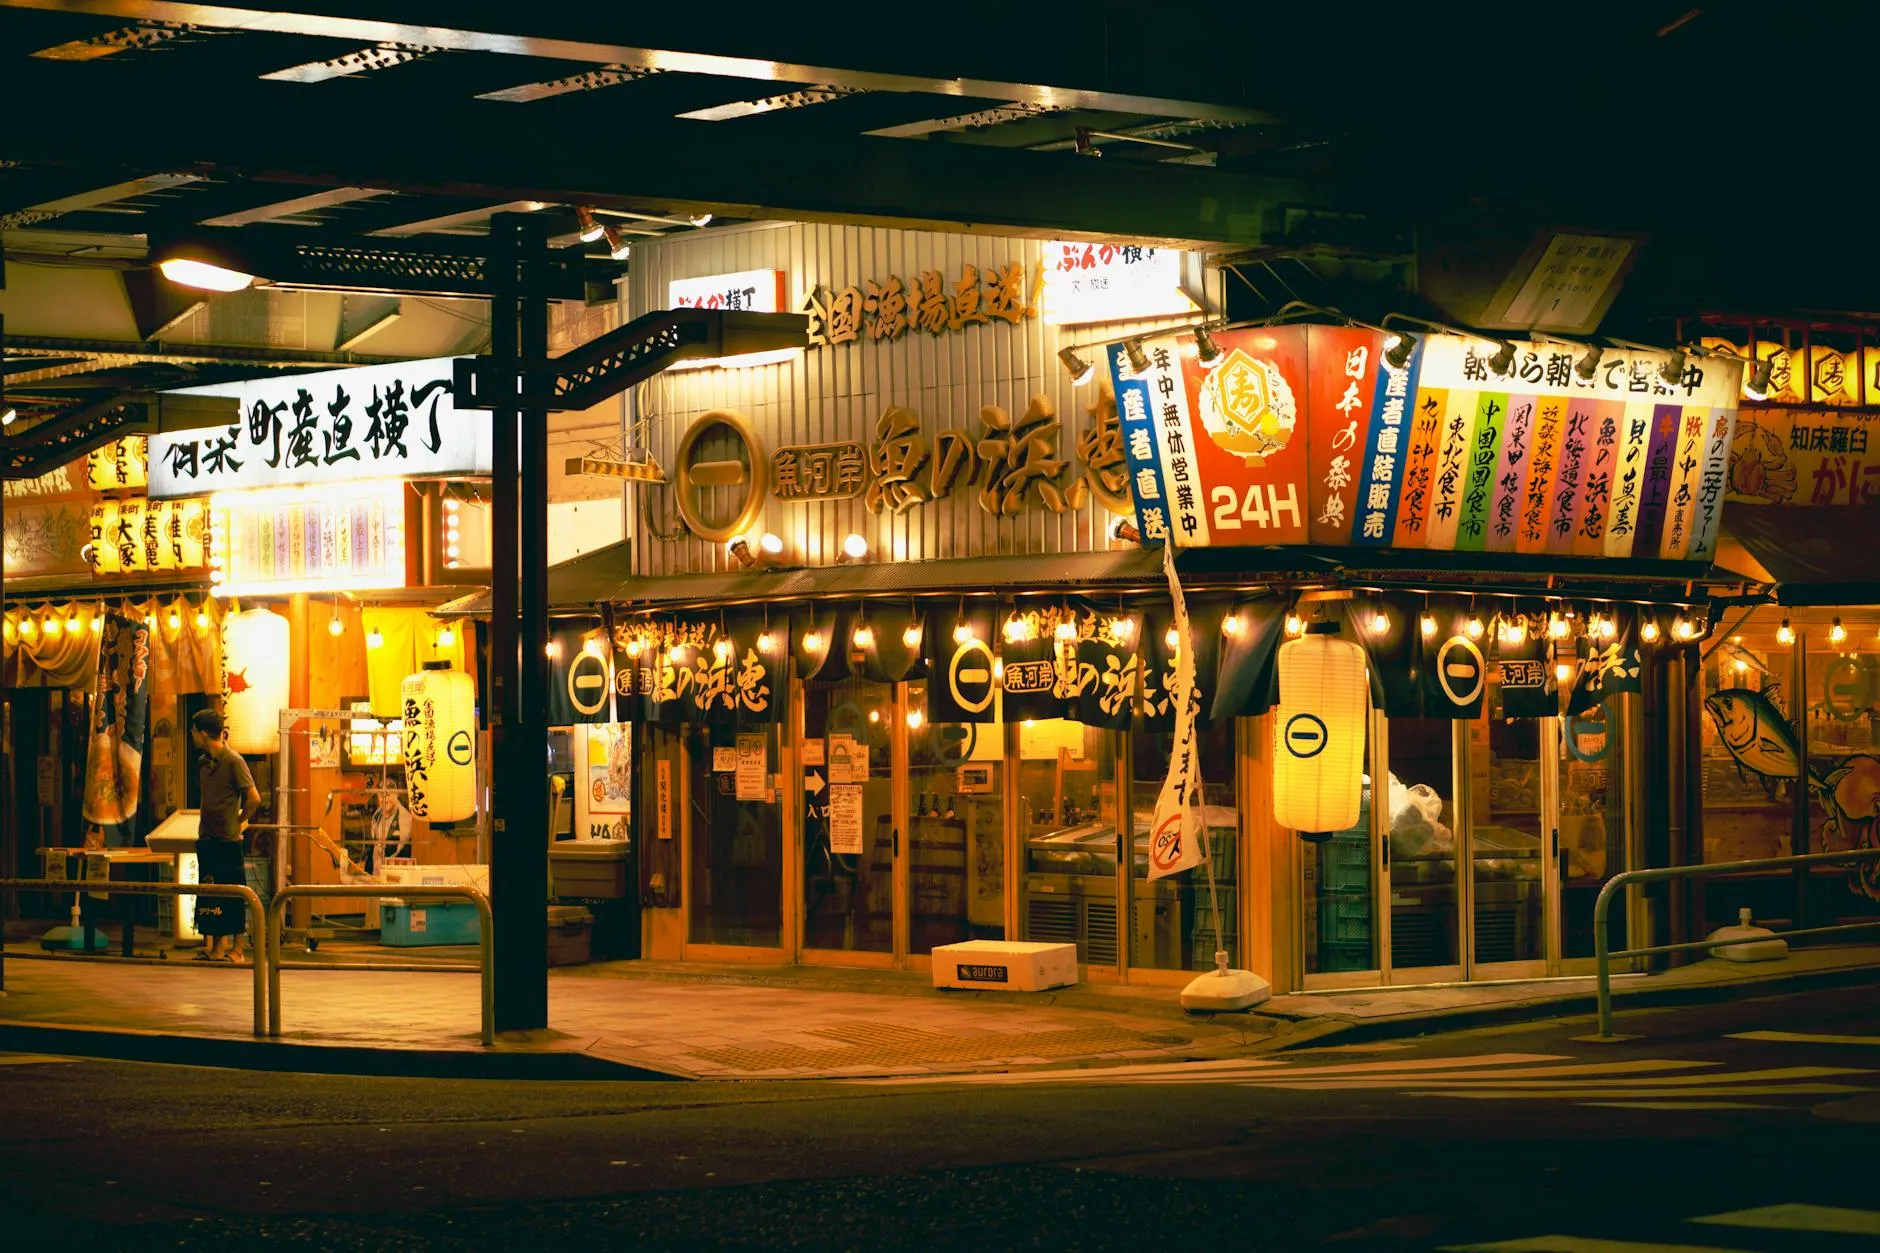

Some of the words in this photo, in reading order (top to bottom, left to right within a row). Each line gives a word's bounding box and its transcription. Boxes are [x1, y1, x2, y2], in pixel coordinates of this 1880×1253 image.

[773, 446, 866, 498] 魚河岸
[1151, 346, 1198, 537] 年中無休営業中
[1315, 345, 1369, 528] 日本の祭典
[1363, 357, 1411, 539] 産者直結販売
[1402, 394, 1441, 538] 九州沖縄食市
[1434, 413, 1466, 524] 東北食市
[1461, 399, 1501, 541] 中国四国食市
[1553, 410, 1590, 540] 北海道食市
[1789, 424, 1868, 455] 知床羅臼
[1211, 482, 1302, 530] 24H
[1005, 665, 1052, 690] 魚河岸
[403, 697, 429, 818] 魚の浜恵
[972, 966, 1003, 978] aurora
